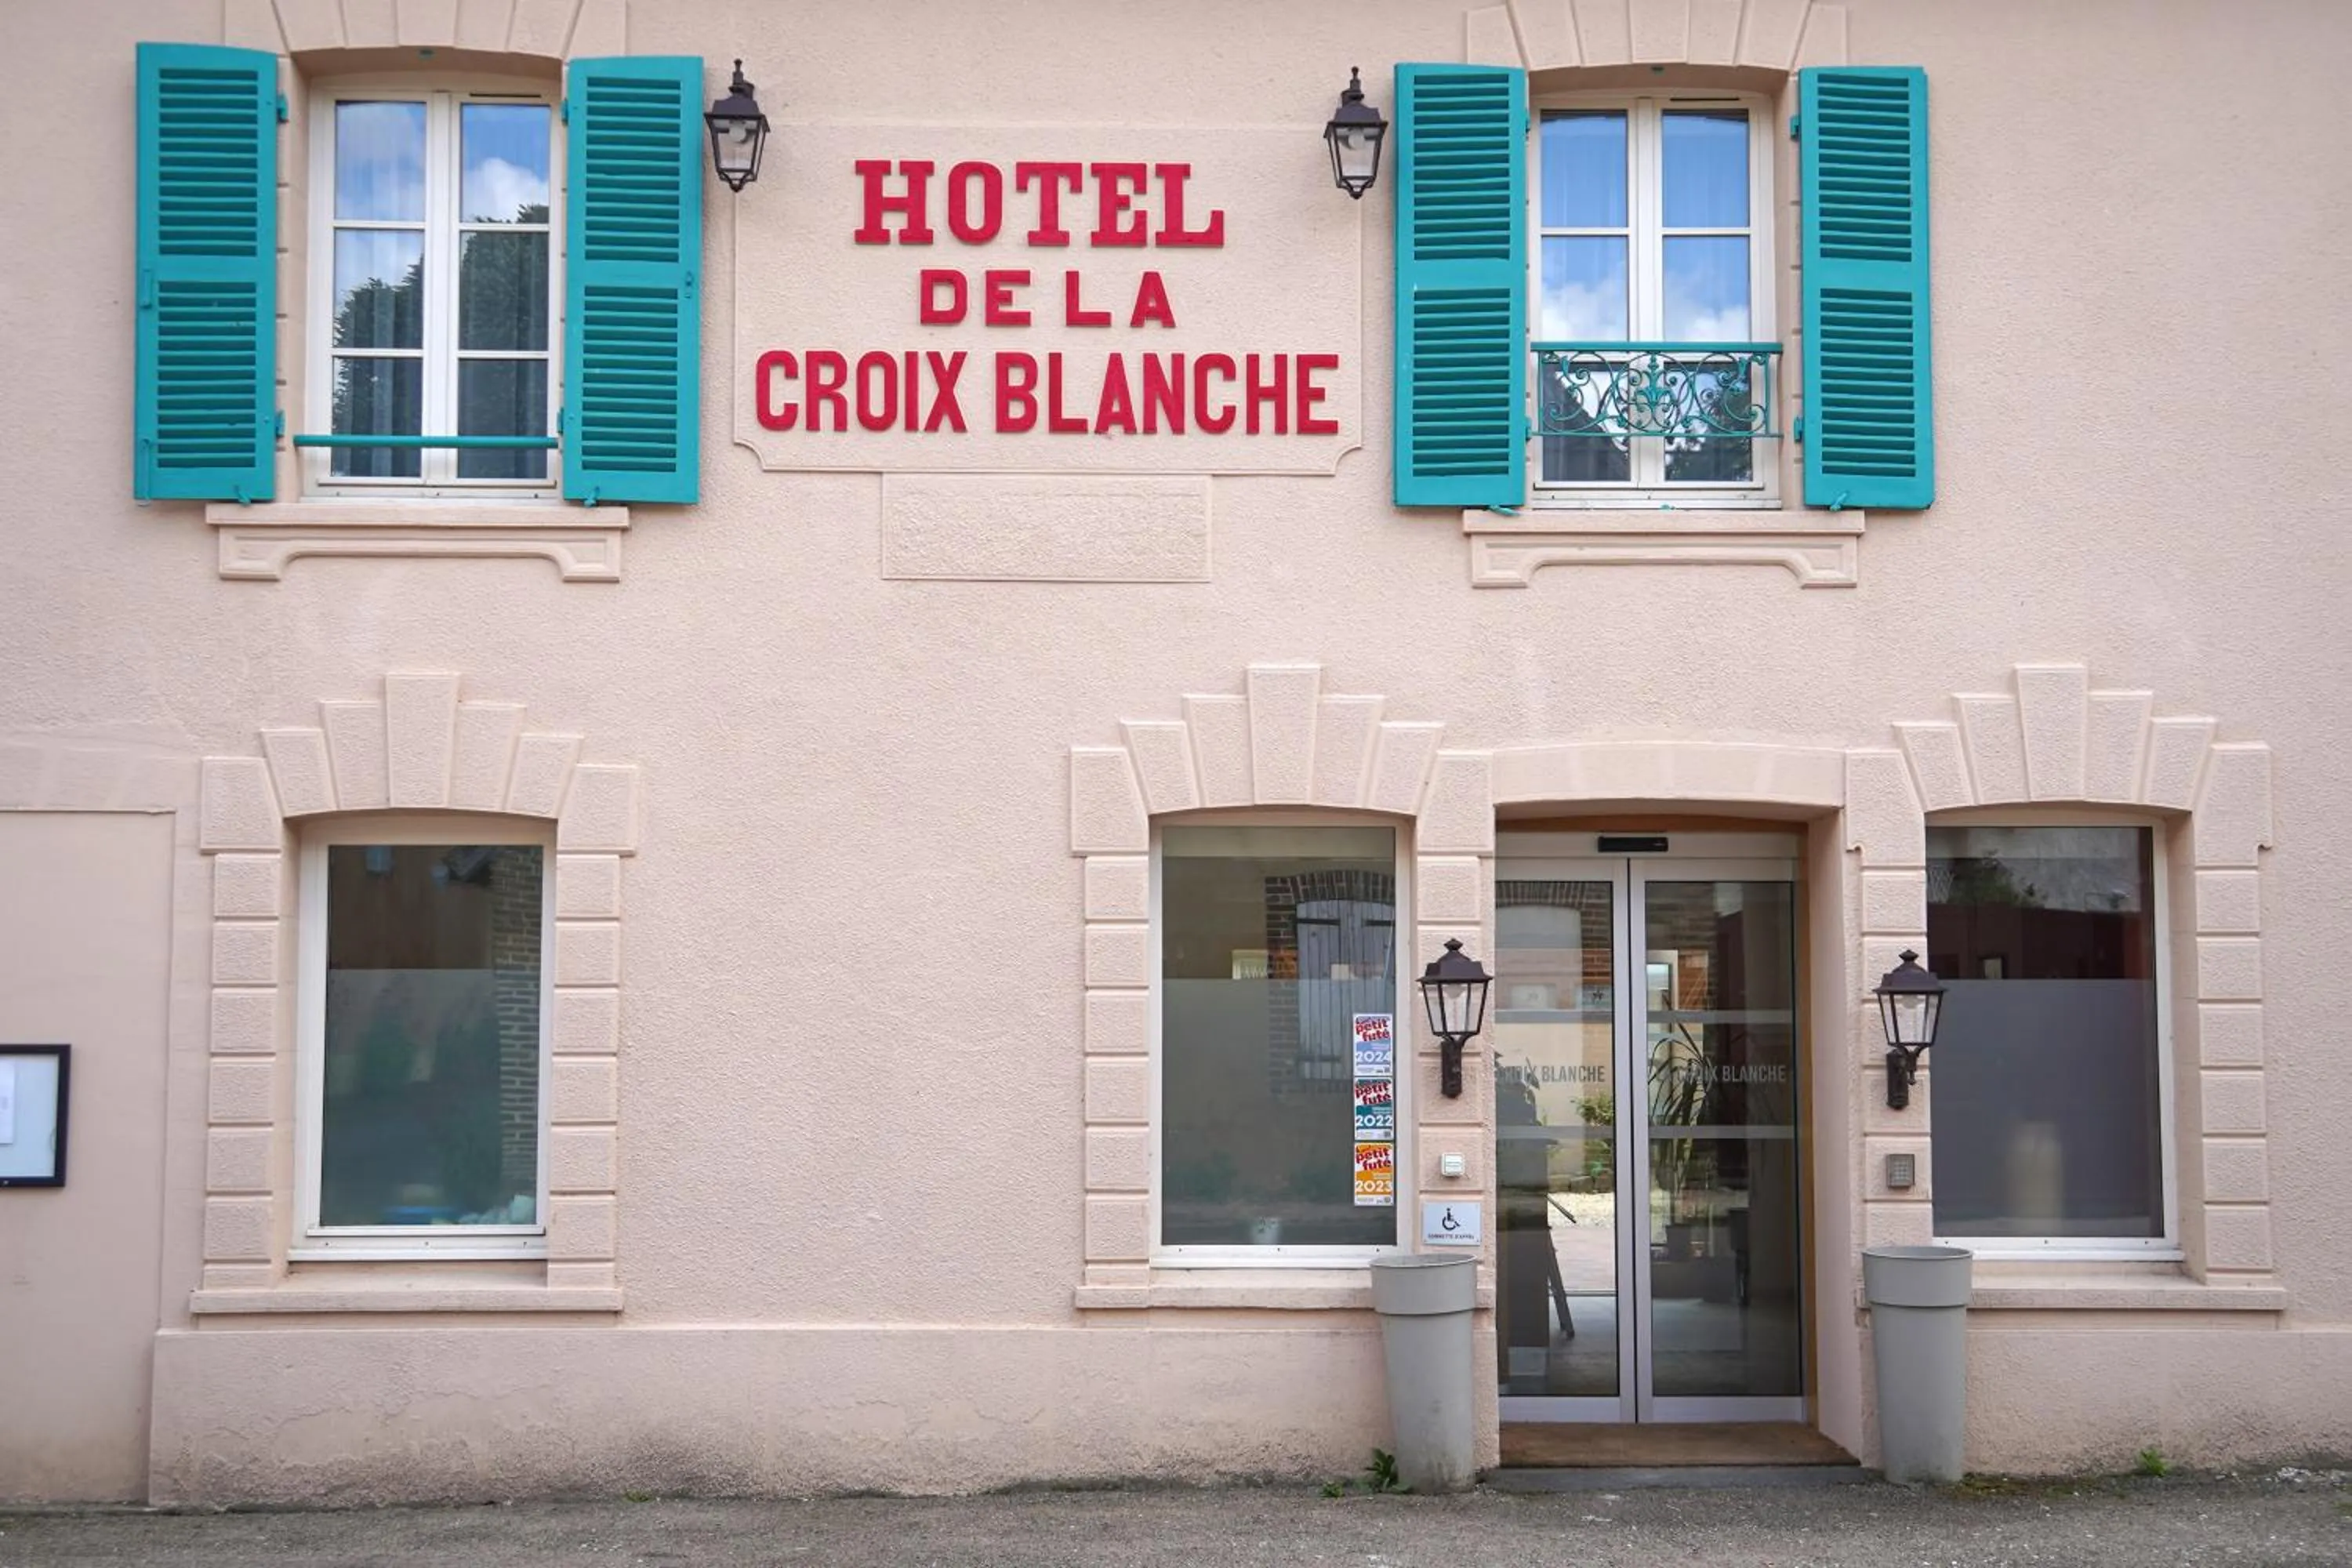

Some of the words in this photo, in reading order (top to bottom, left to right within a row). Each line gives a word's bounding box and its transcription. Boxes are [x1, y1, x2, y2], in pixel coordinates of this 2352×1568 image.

[855, 159, 1225, 248] HOTEL
[920, 269, 1032, 326] DE
[1065, 270, 1175, 328] LA
[756, 350, 967, 433] CROIX
[995, 351, 1339, 434] BLANCHE
[1356, 1018, 1388, 1035] petit
[1356, 1051, 1391, 1062] 2024
[1541, 1065, 1606, 1083] BLANCHE
[1722, 1065, 1787, 1083] BLANCHE
[1355, 1082, 1389, 1098] petit
[1355, 1115, 1392, 1127] 2022
[1356, 1148, 1390, 1164] petit
[1355, 1180, 1392, 1192] 2023
